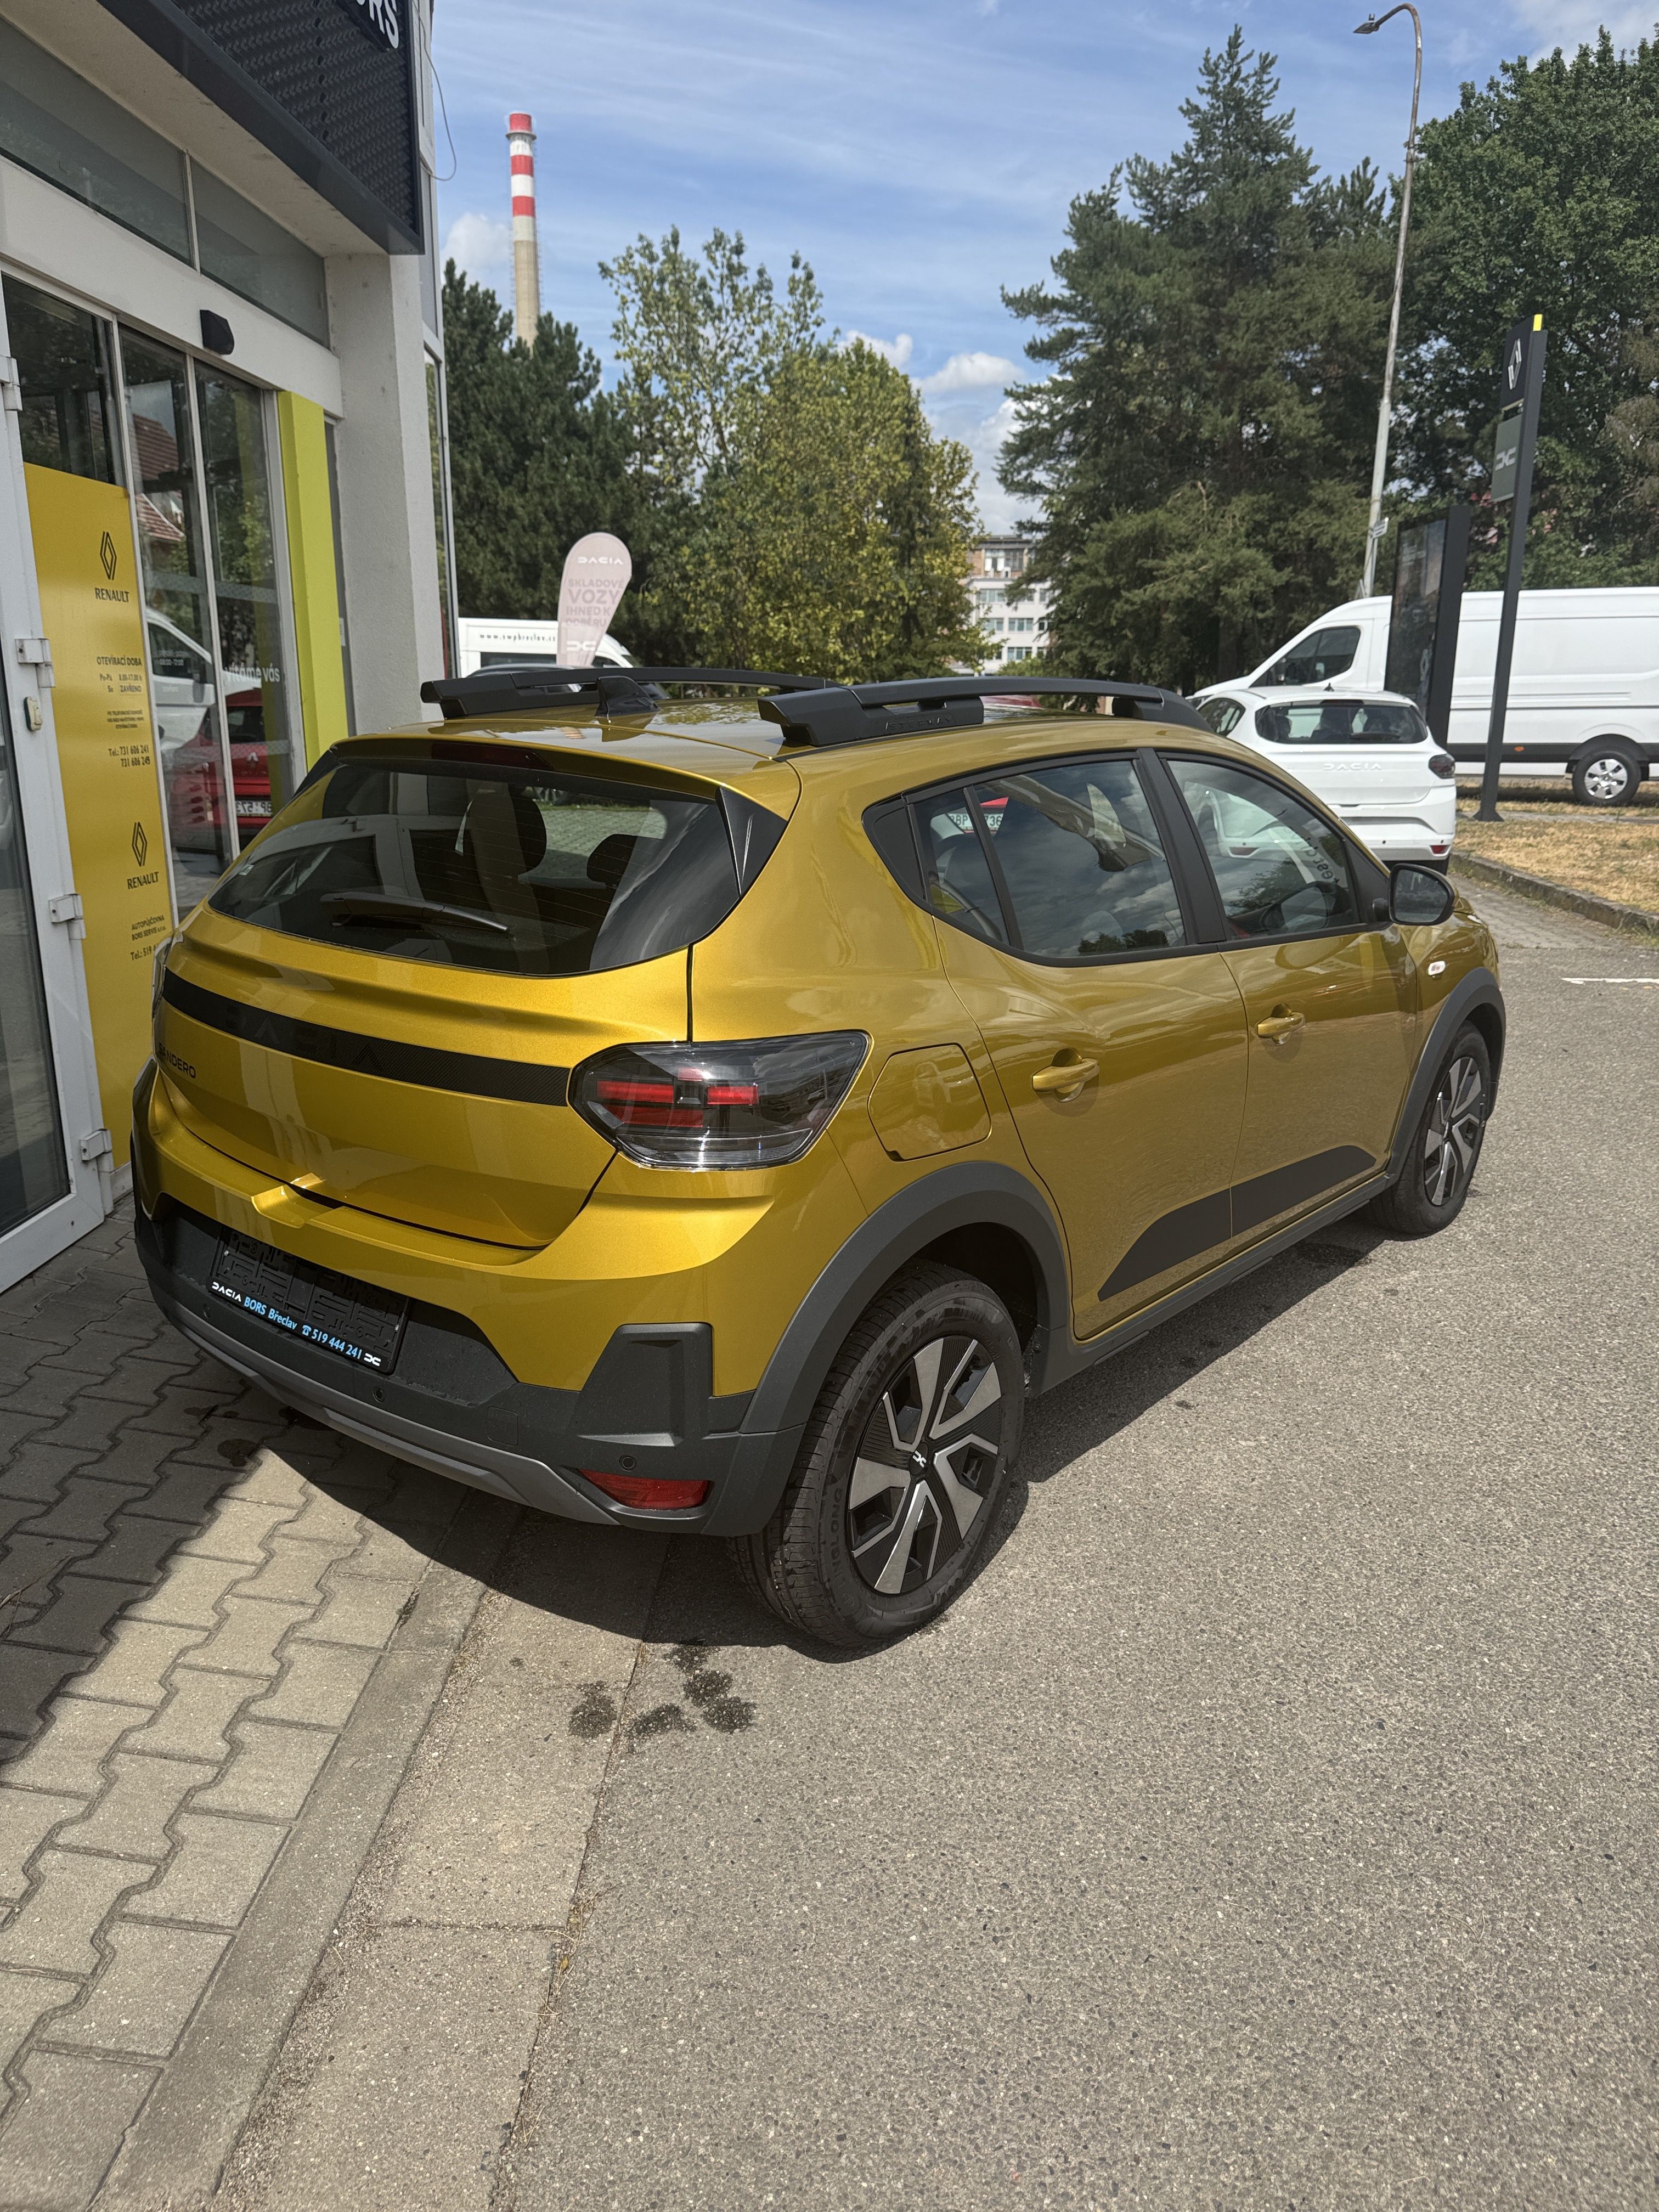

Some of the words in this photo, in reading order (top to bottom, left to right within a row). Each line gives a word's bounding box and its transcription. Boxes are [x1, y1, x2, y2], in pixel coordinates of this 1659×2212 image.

[355, 0, 399, 49] RS
[577, 556, 623, 566] DACIA
[567, 579, 625, 589] SKLADOVÉ
[95, 588, 129, 602] RENAULT
[567, 589, 620, 604] VOZY
[566, 606, 601, 616] IHNED
[602, 607, 611, 617] K
[225, 662, 261, 682] vítáme
[263, 663, 280, 682] vás
[1322, 763, 1382, 771] DACIA
[127, 871, 159, 890] RENAULT
[143, 927, 157, 937] SERVIS
[158, 1042, 196, 1079] SANDERO
[211, 1281, 242, 1303] DACIA
[244, 1295, 267, 1316] BORS
[268, 1307, 298, 1330] Břeclav
[312, 1328, 329, 1344] 519
[328, 1337, 345, 1352] 444
[345, 1344, 362, 1360] 241
